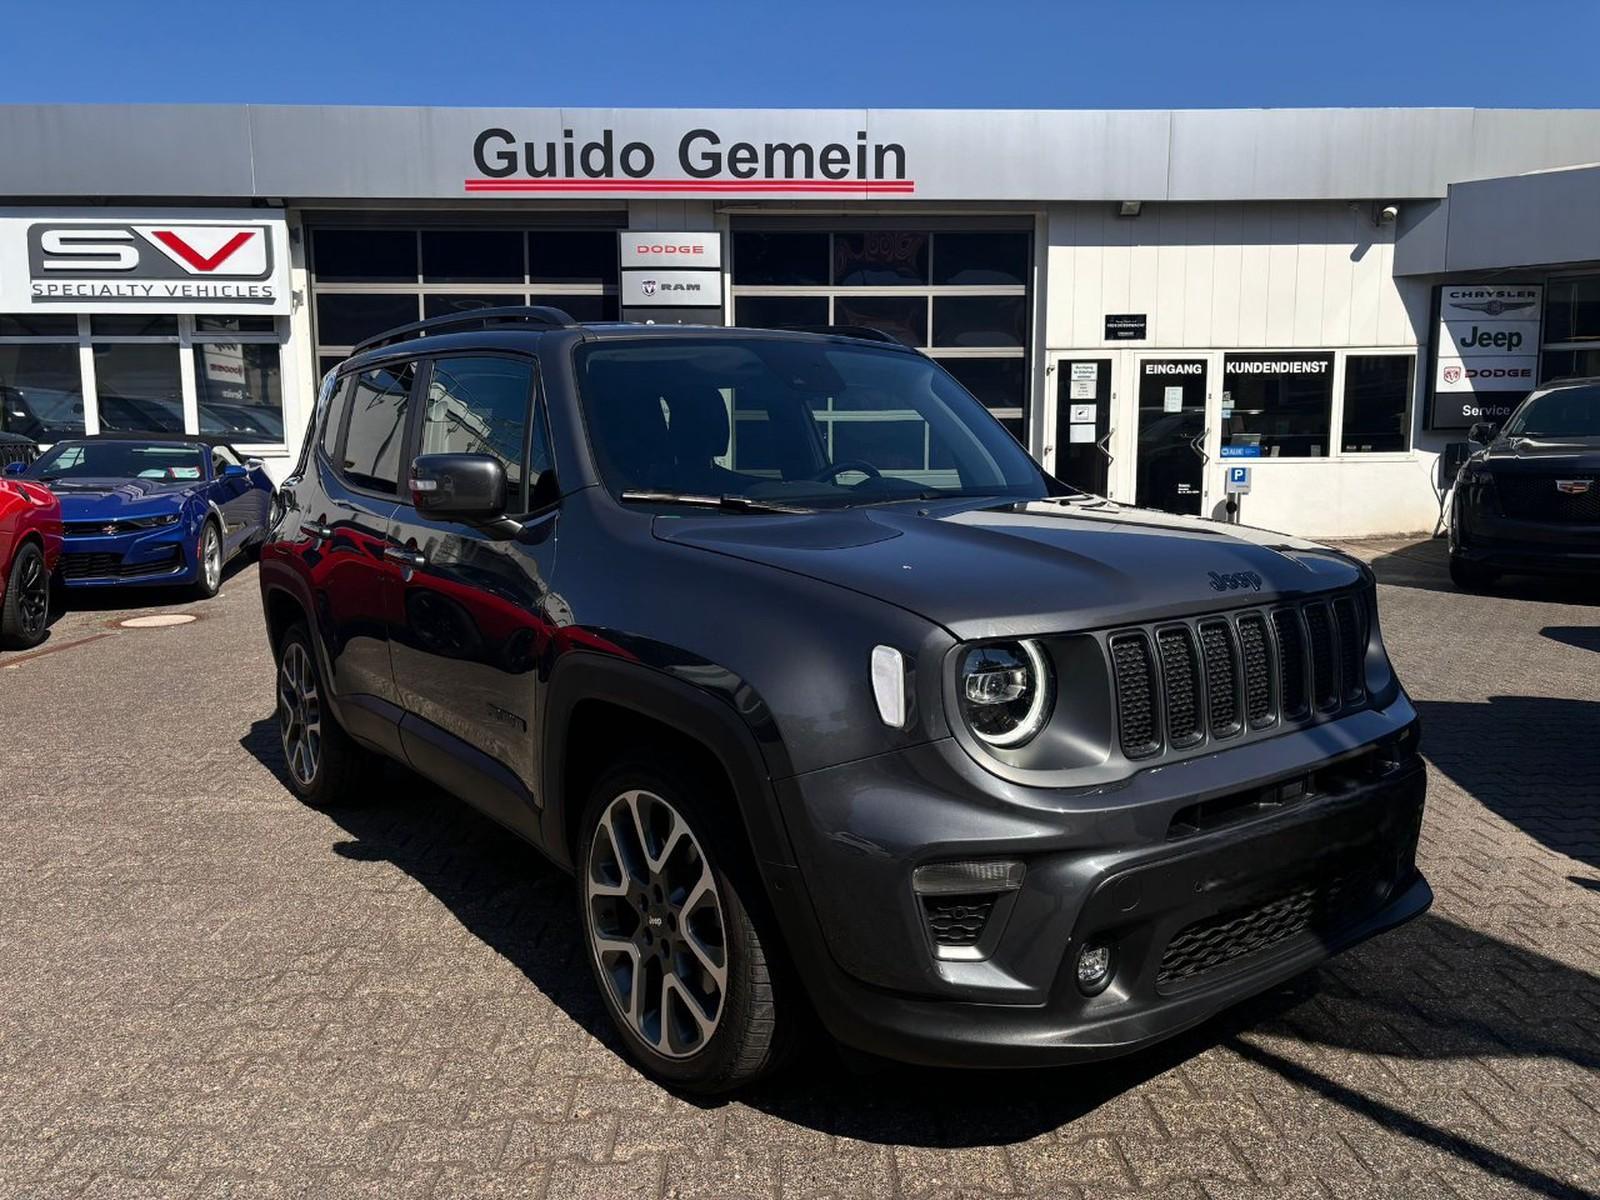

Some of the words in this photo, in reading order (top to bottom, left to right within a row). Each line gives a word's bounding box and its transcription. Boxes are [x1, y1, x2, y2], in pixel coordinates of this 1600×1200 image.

[472, 127, 655, 179] Guido
[678, 128, 907, 180] Gemein
[41, 229, 256, 272] SV
[637, 245, 704, 254] DODGE
[32, 283, 153, 297] SPECIALTY
[165, 284, 273, 298] VEHICLES
[660, 283, 701, 291] RAM
[1450, 290, 1536, 298] CHRYSLER
[1460, 326, 1522, 351] Jeep
[1146, 364, 1202, 375] EINGANG
[1226, 361, 1328, 374] KUNDENDIENST
[1465, 368, 1531, 378] DODGE
[1462, 404, 1511, 416] Service
[1234, 469, 1244, 481] P
[1207, 570, 1262, 591] Jeep
